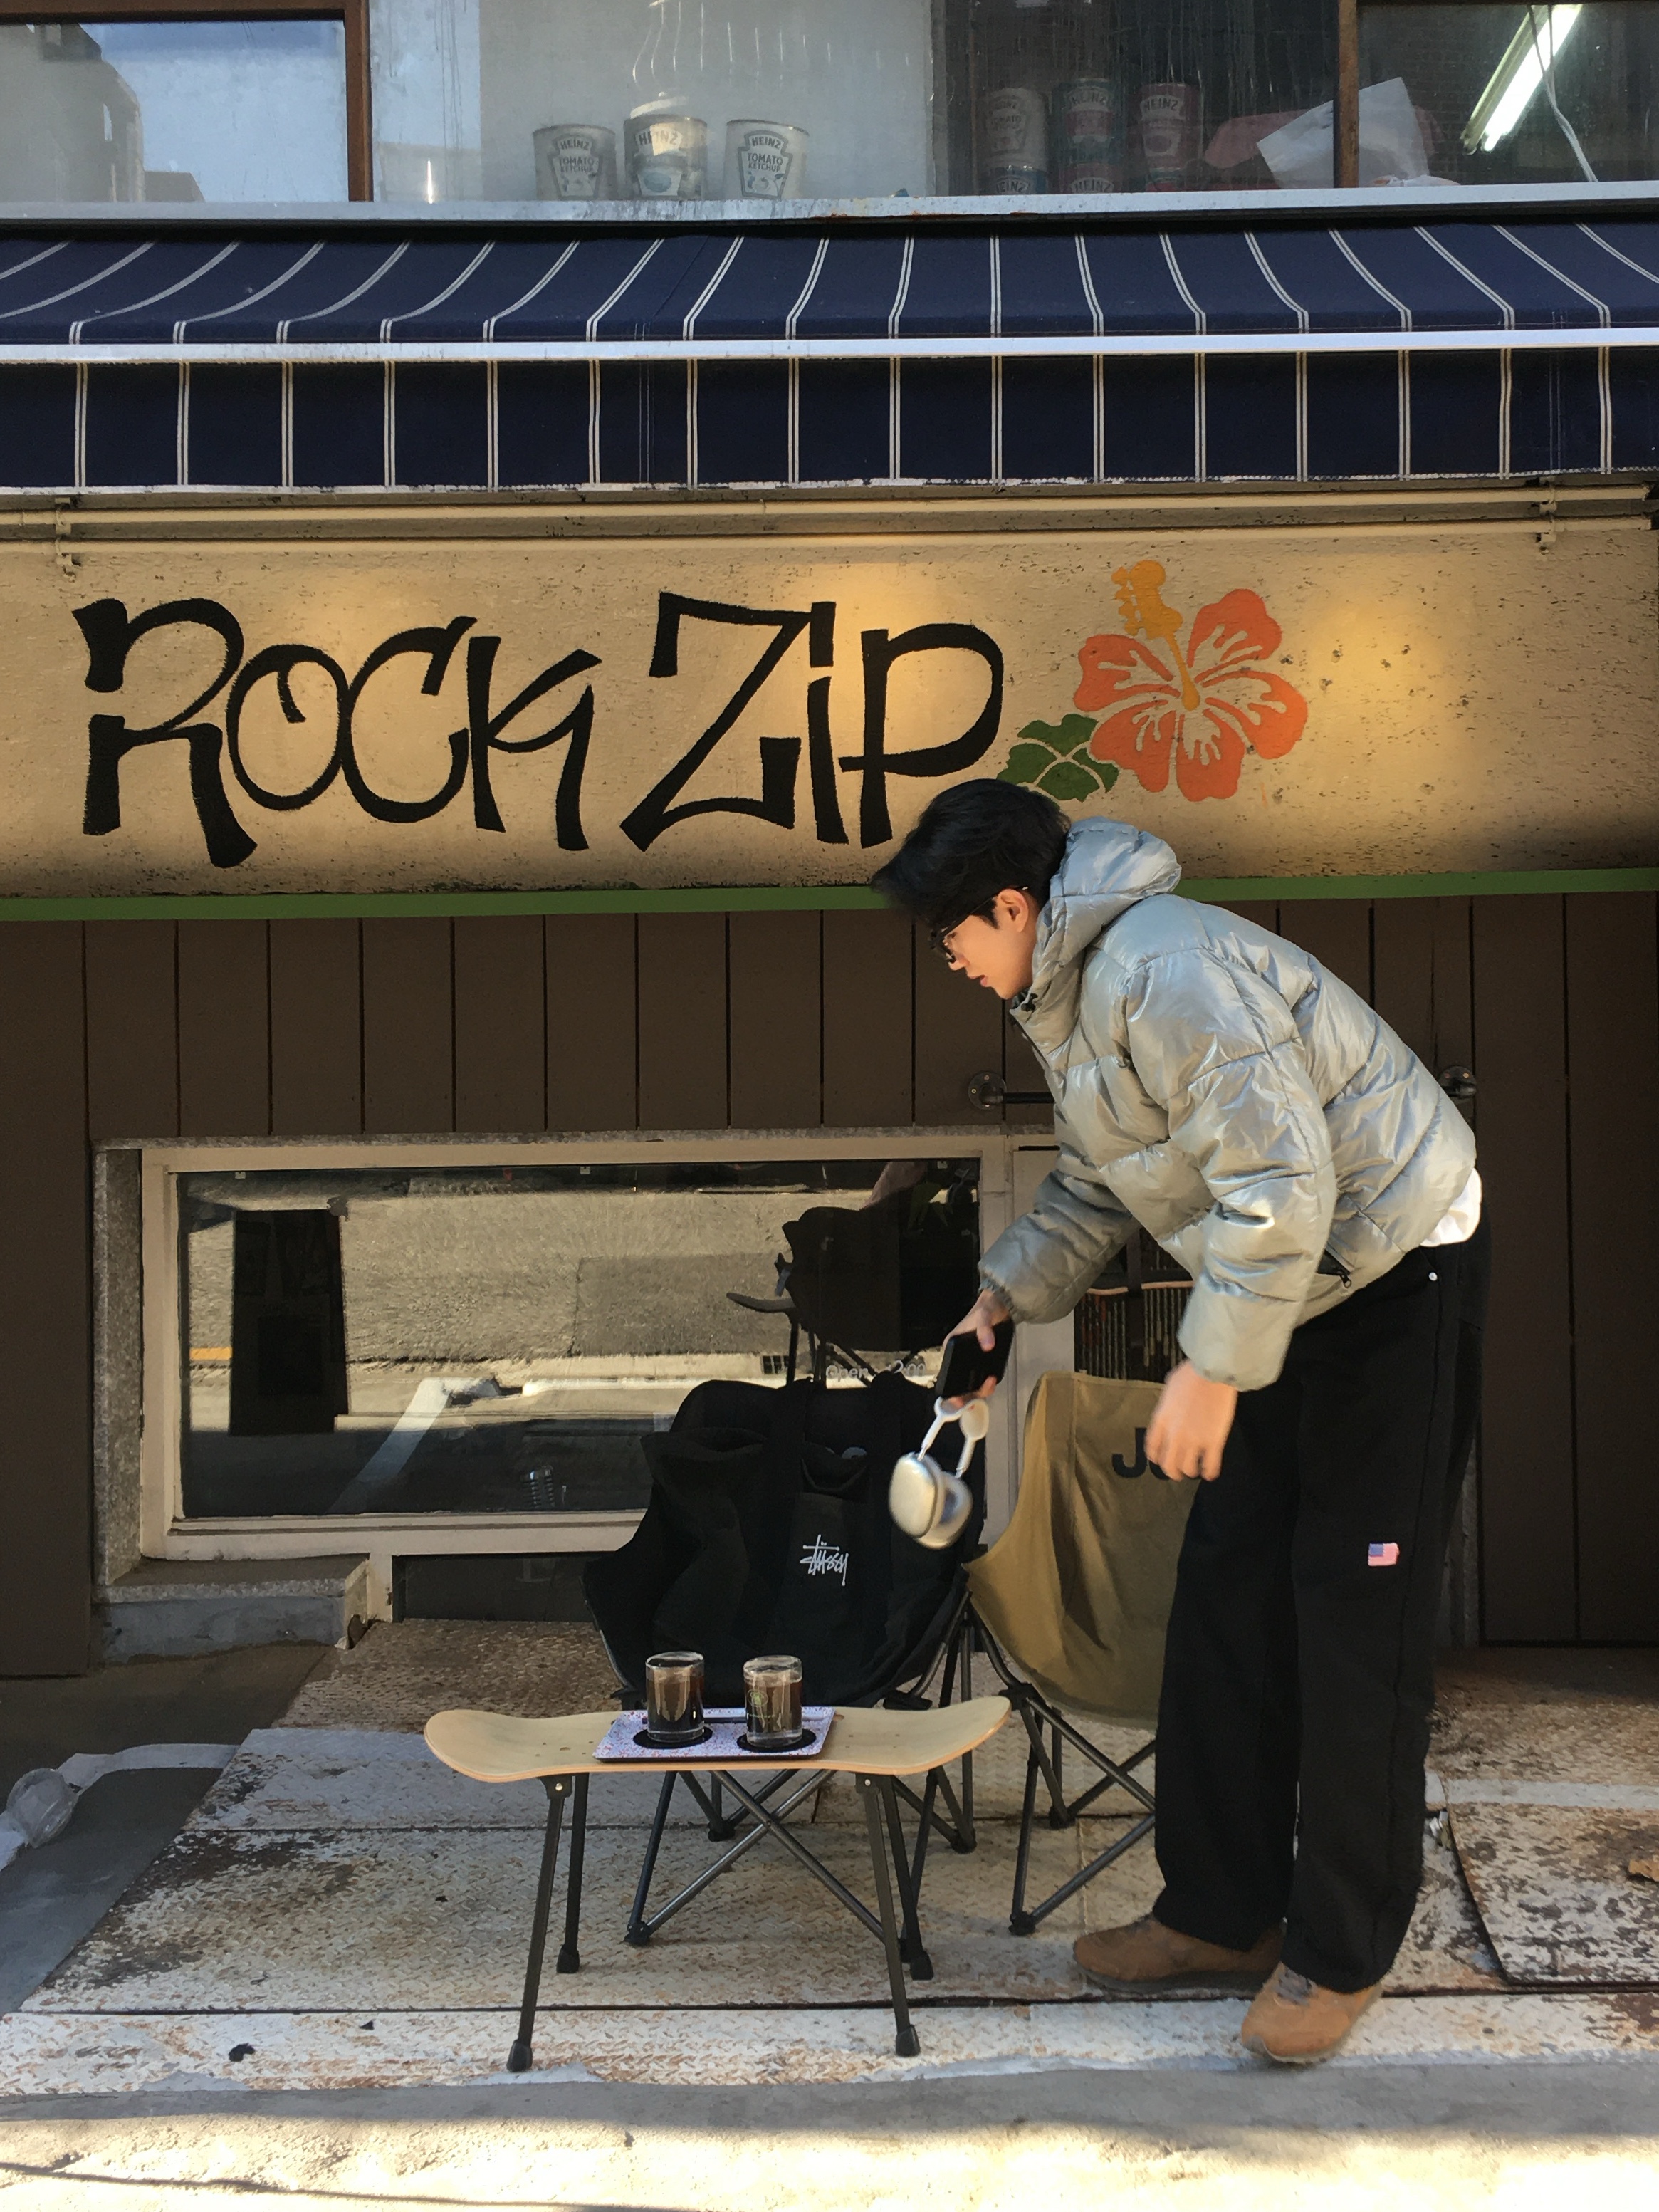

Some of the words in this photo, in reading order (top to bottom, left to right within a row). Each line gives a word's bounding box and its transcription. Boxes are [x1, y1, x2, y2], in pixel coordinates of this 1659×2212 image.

[1146, 98, 1179, 110] HEINZ
[560, 139, 590, 151] HEINZ
[752, 136, 782, 150] HEINZ
[559, 156, 595, 166] TOMATO
[748, 152, 783, 166] TOMATO
[748, 162, 781, 172] KETCHUP
[73, 598, 602, 869] ROCK
[826, 1365, 868, 1382] Open
